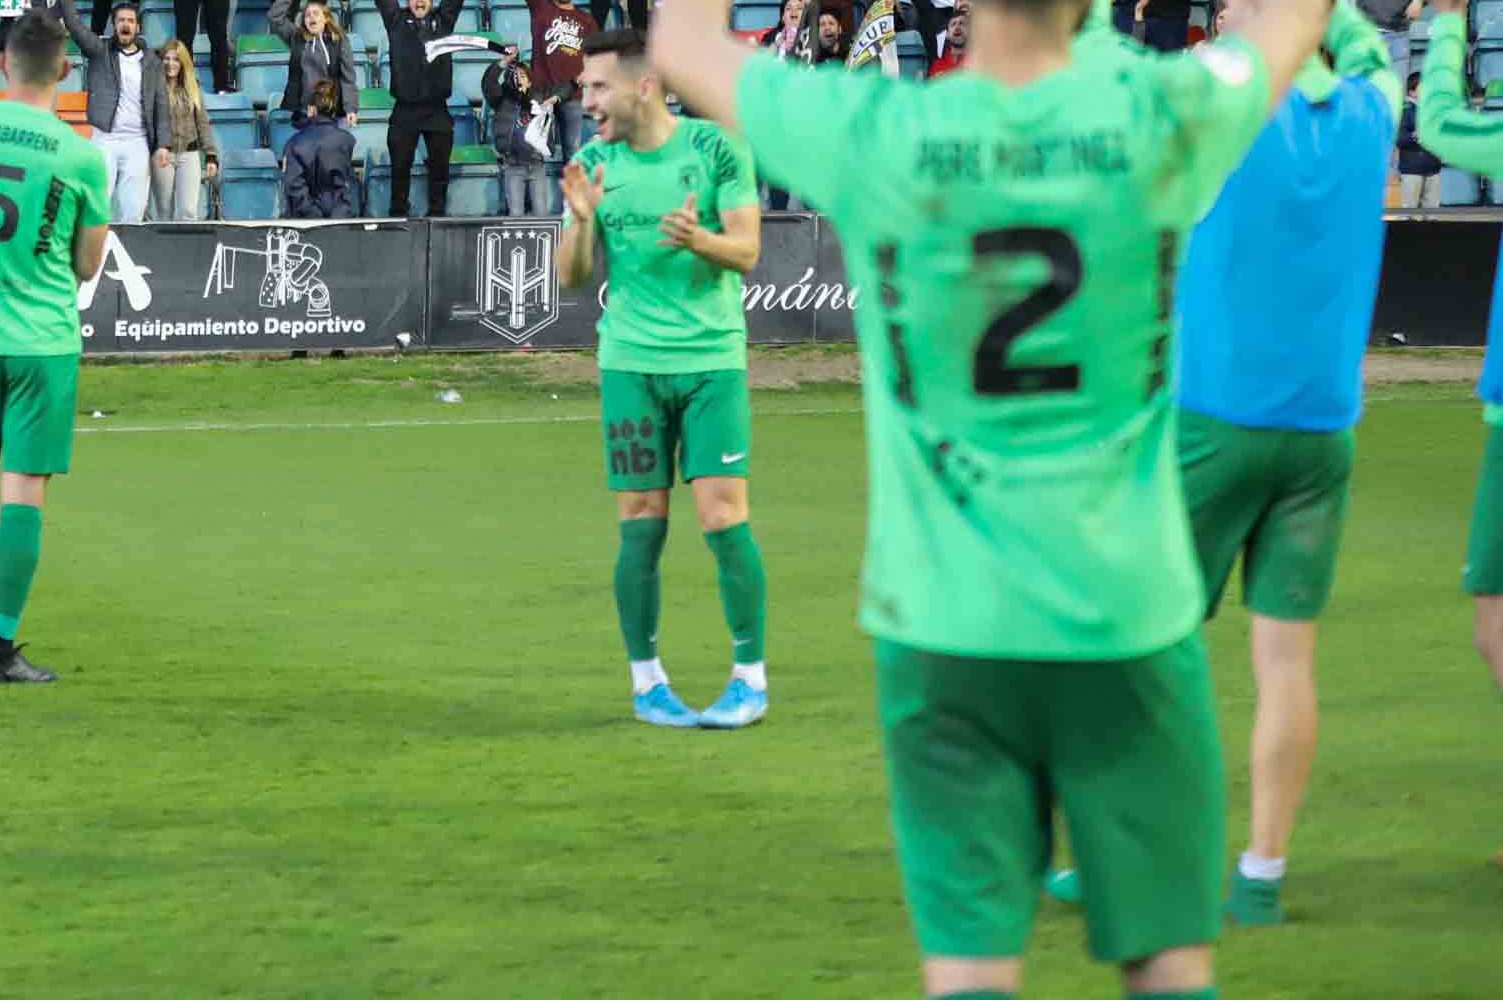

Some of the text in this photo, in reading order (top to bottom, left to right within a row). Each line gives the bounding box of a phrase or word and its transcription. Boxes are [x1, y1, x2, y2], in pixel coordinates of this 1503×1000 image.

[114, 318, 259, 341] Equipamiento
[264, 316, 366, 339] Deportivo
[970, 222, 1085, 396] 2
